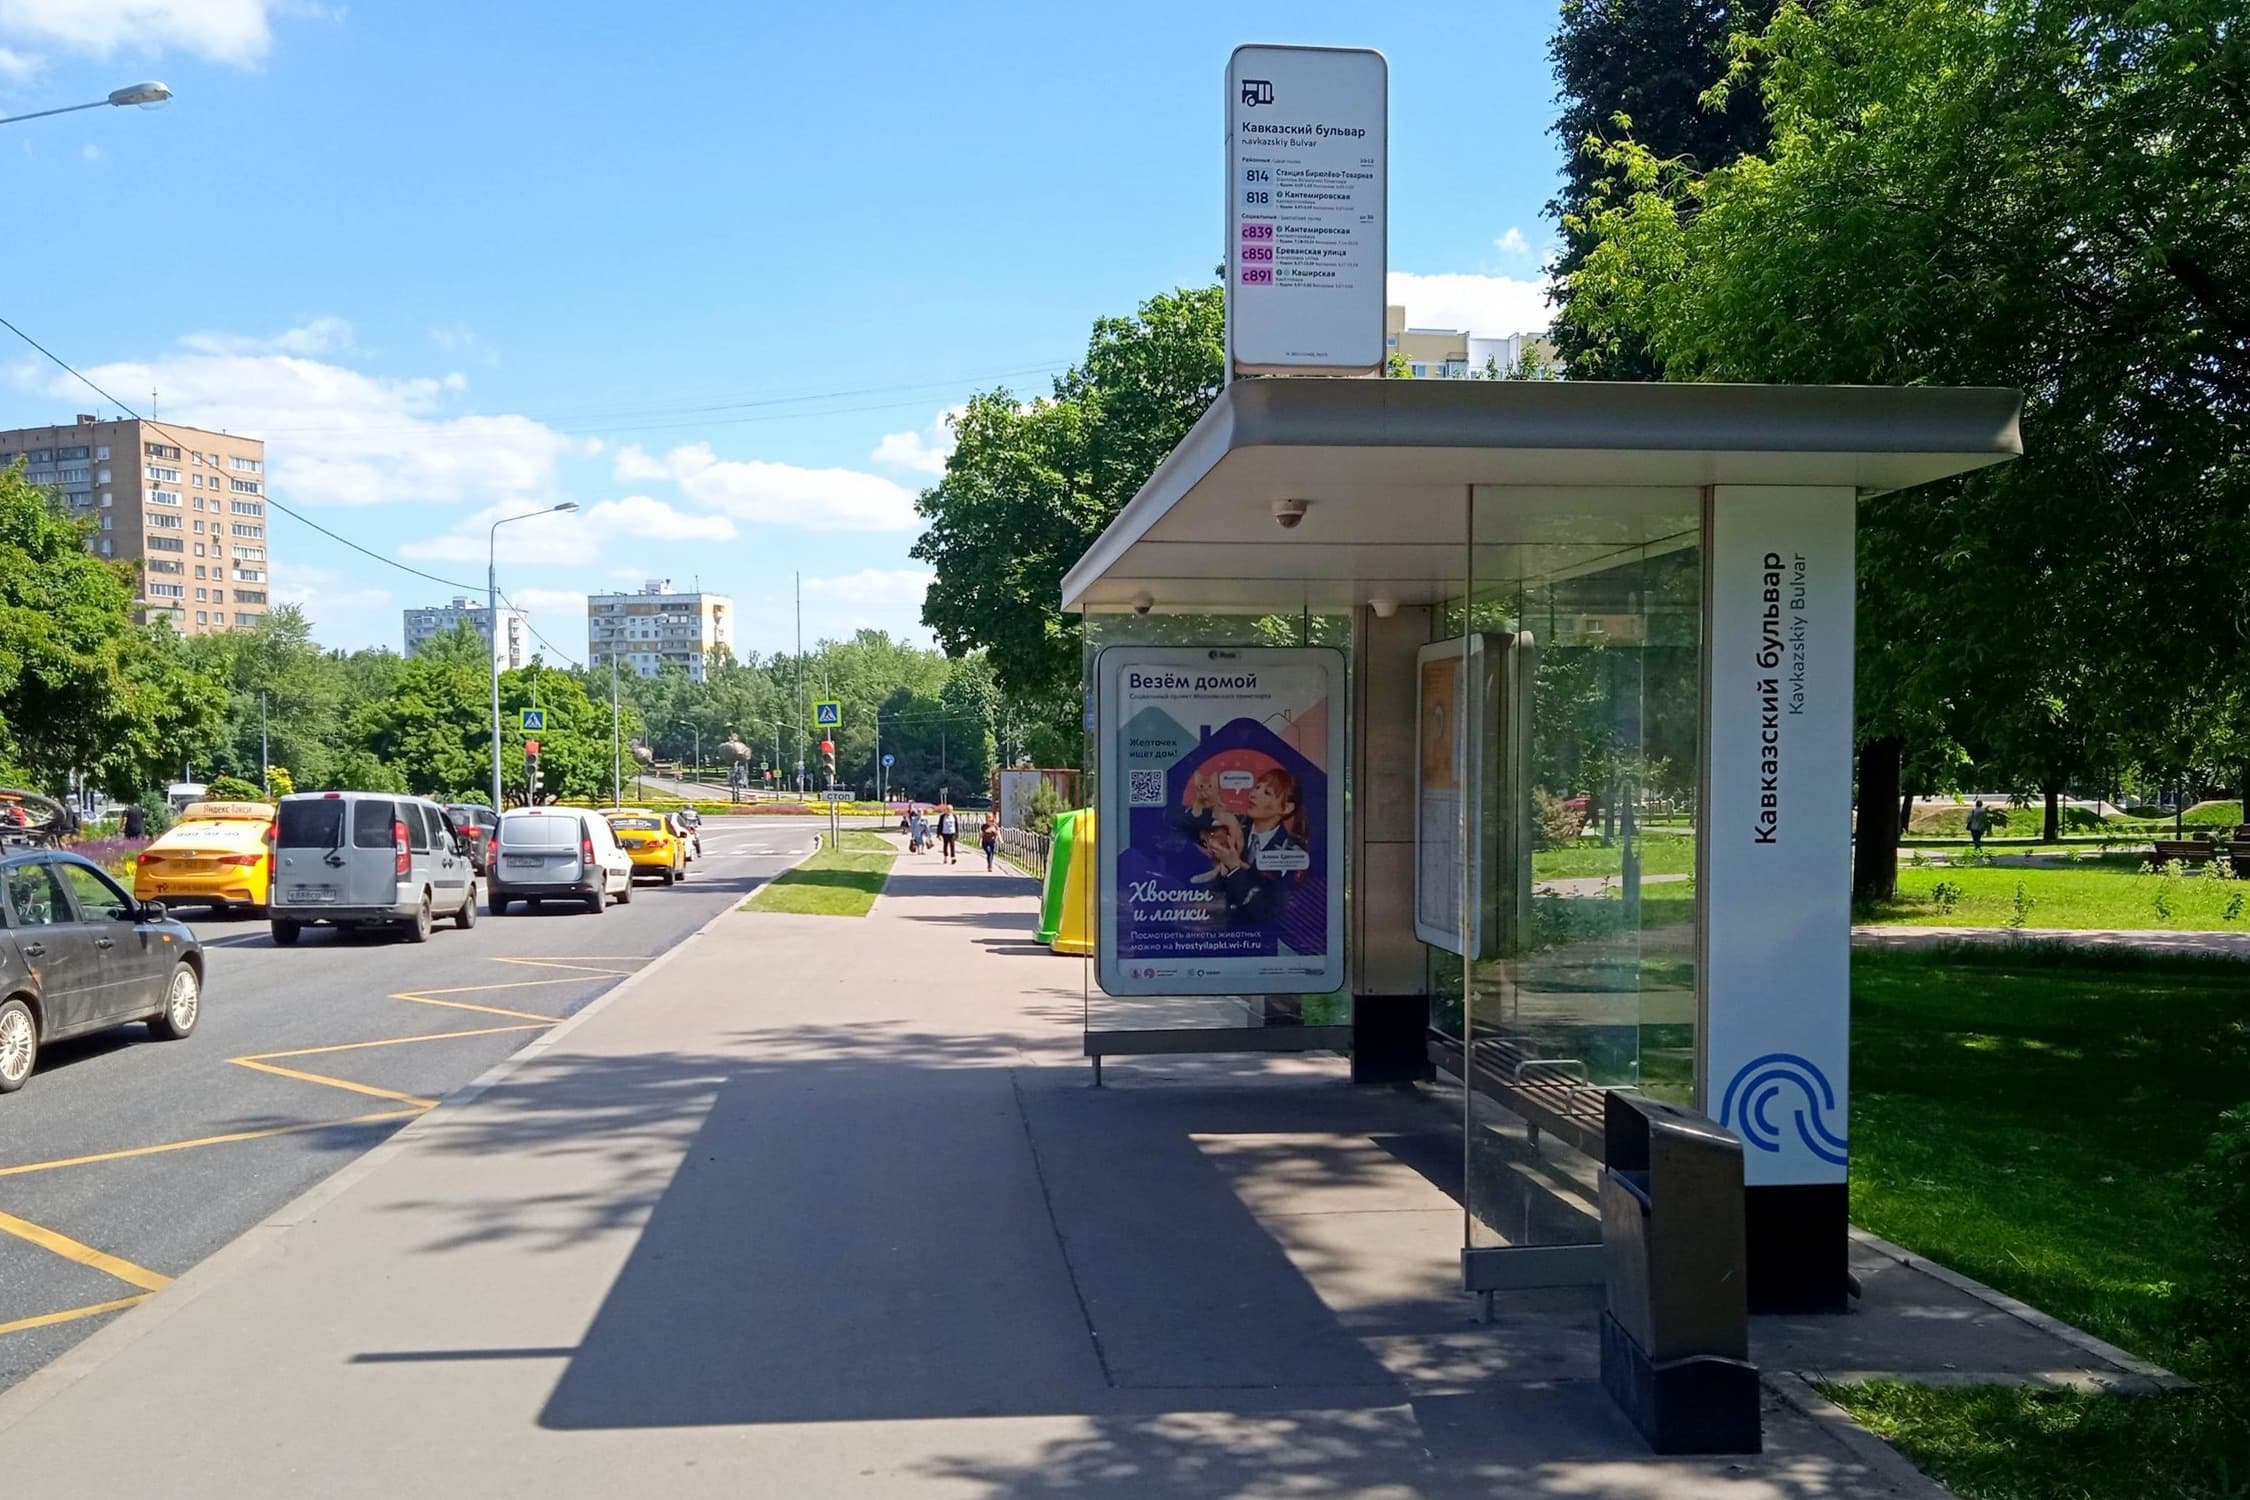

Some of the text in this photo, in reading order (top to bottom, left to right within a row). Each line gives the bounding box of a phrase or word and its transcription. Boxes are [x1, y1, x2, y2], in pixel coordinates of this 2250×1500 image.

[1242, 122, 1365, 138] Кавказский бульвар
[1290, 139, 1317, 147] Bulvar
[1246, 170, 1269, 182] 814
[1276, 169, 1304, 177] Станция
[1246, 191, 1269, 204] 818
[1285, 191, 1351, 200] Кантемировская
[1285, 225, 1350, 235] Кантемировская
[1276, 247, 1321, 256] Ереванская
[1323, 249, 1347, 257] улица
[1292, 269, 1335, 278] Каширская
[1789, 552, 1808, 714] Kavkazskiy Bulvar
[1130, 673, 1257, 691] Везём домой
[1755, 552, 1786, 844] Кавказский бульвар
[1129, 750, 1178, 759] ищет дом!
[1129, 879, 1213, 902] Хвосты
[1134, 908, 1210, 921] и лапки
[1130, 931, 1184, 940] Посмотреть
